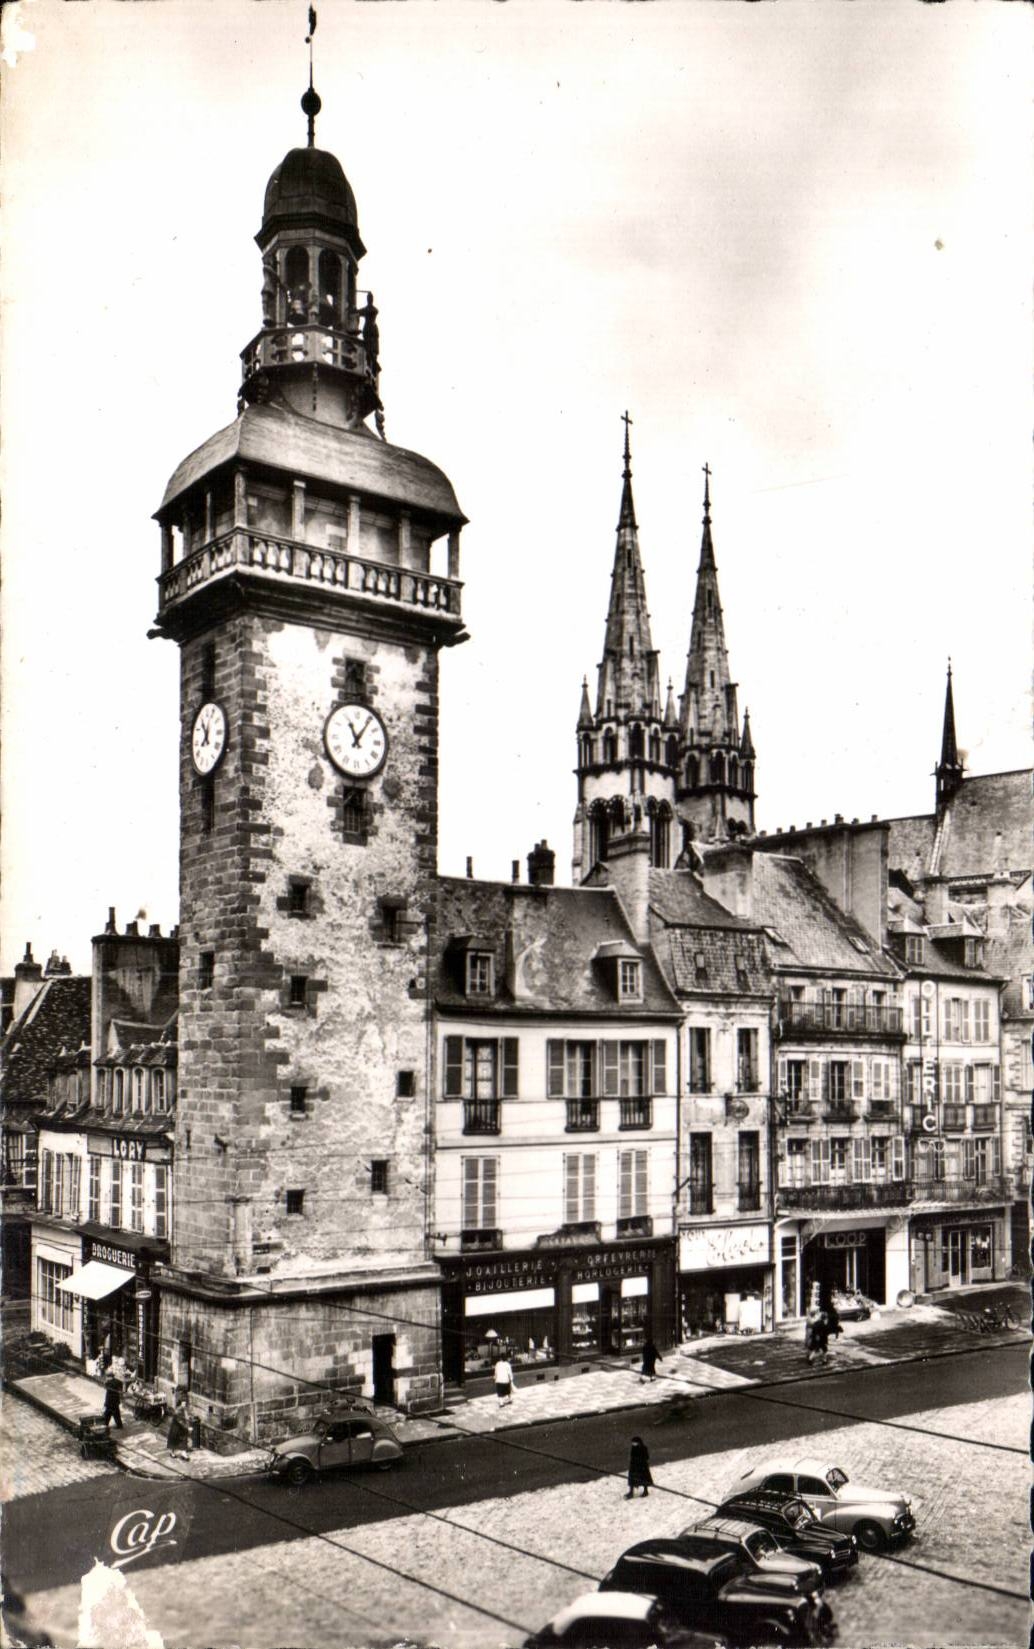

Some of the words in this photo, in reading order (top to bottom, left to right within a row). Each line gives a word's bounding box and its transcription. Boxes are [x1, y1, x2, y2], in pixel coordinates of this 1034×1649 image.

[91, 1242, 137, 1268] DROGUERIE
[465, 1259, 543, 1278] JOAILLERIE
[577, 1265, 645, 1280] HORLOGERIE
[475, 1276, 546, 1292] BIJOUTERIE
